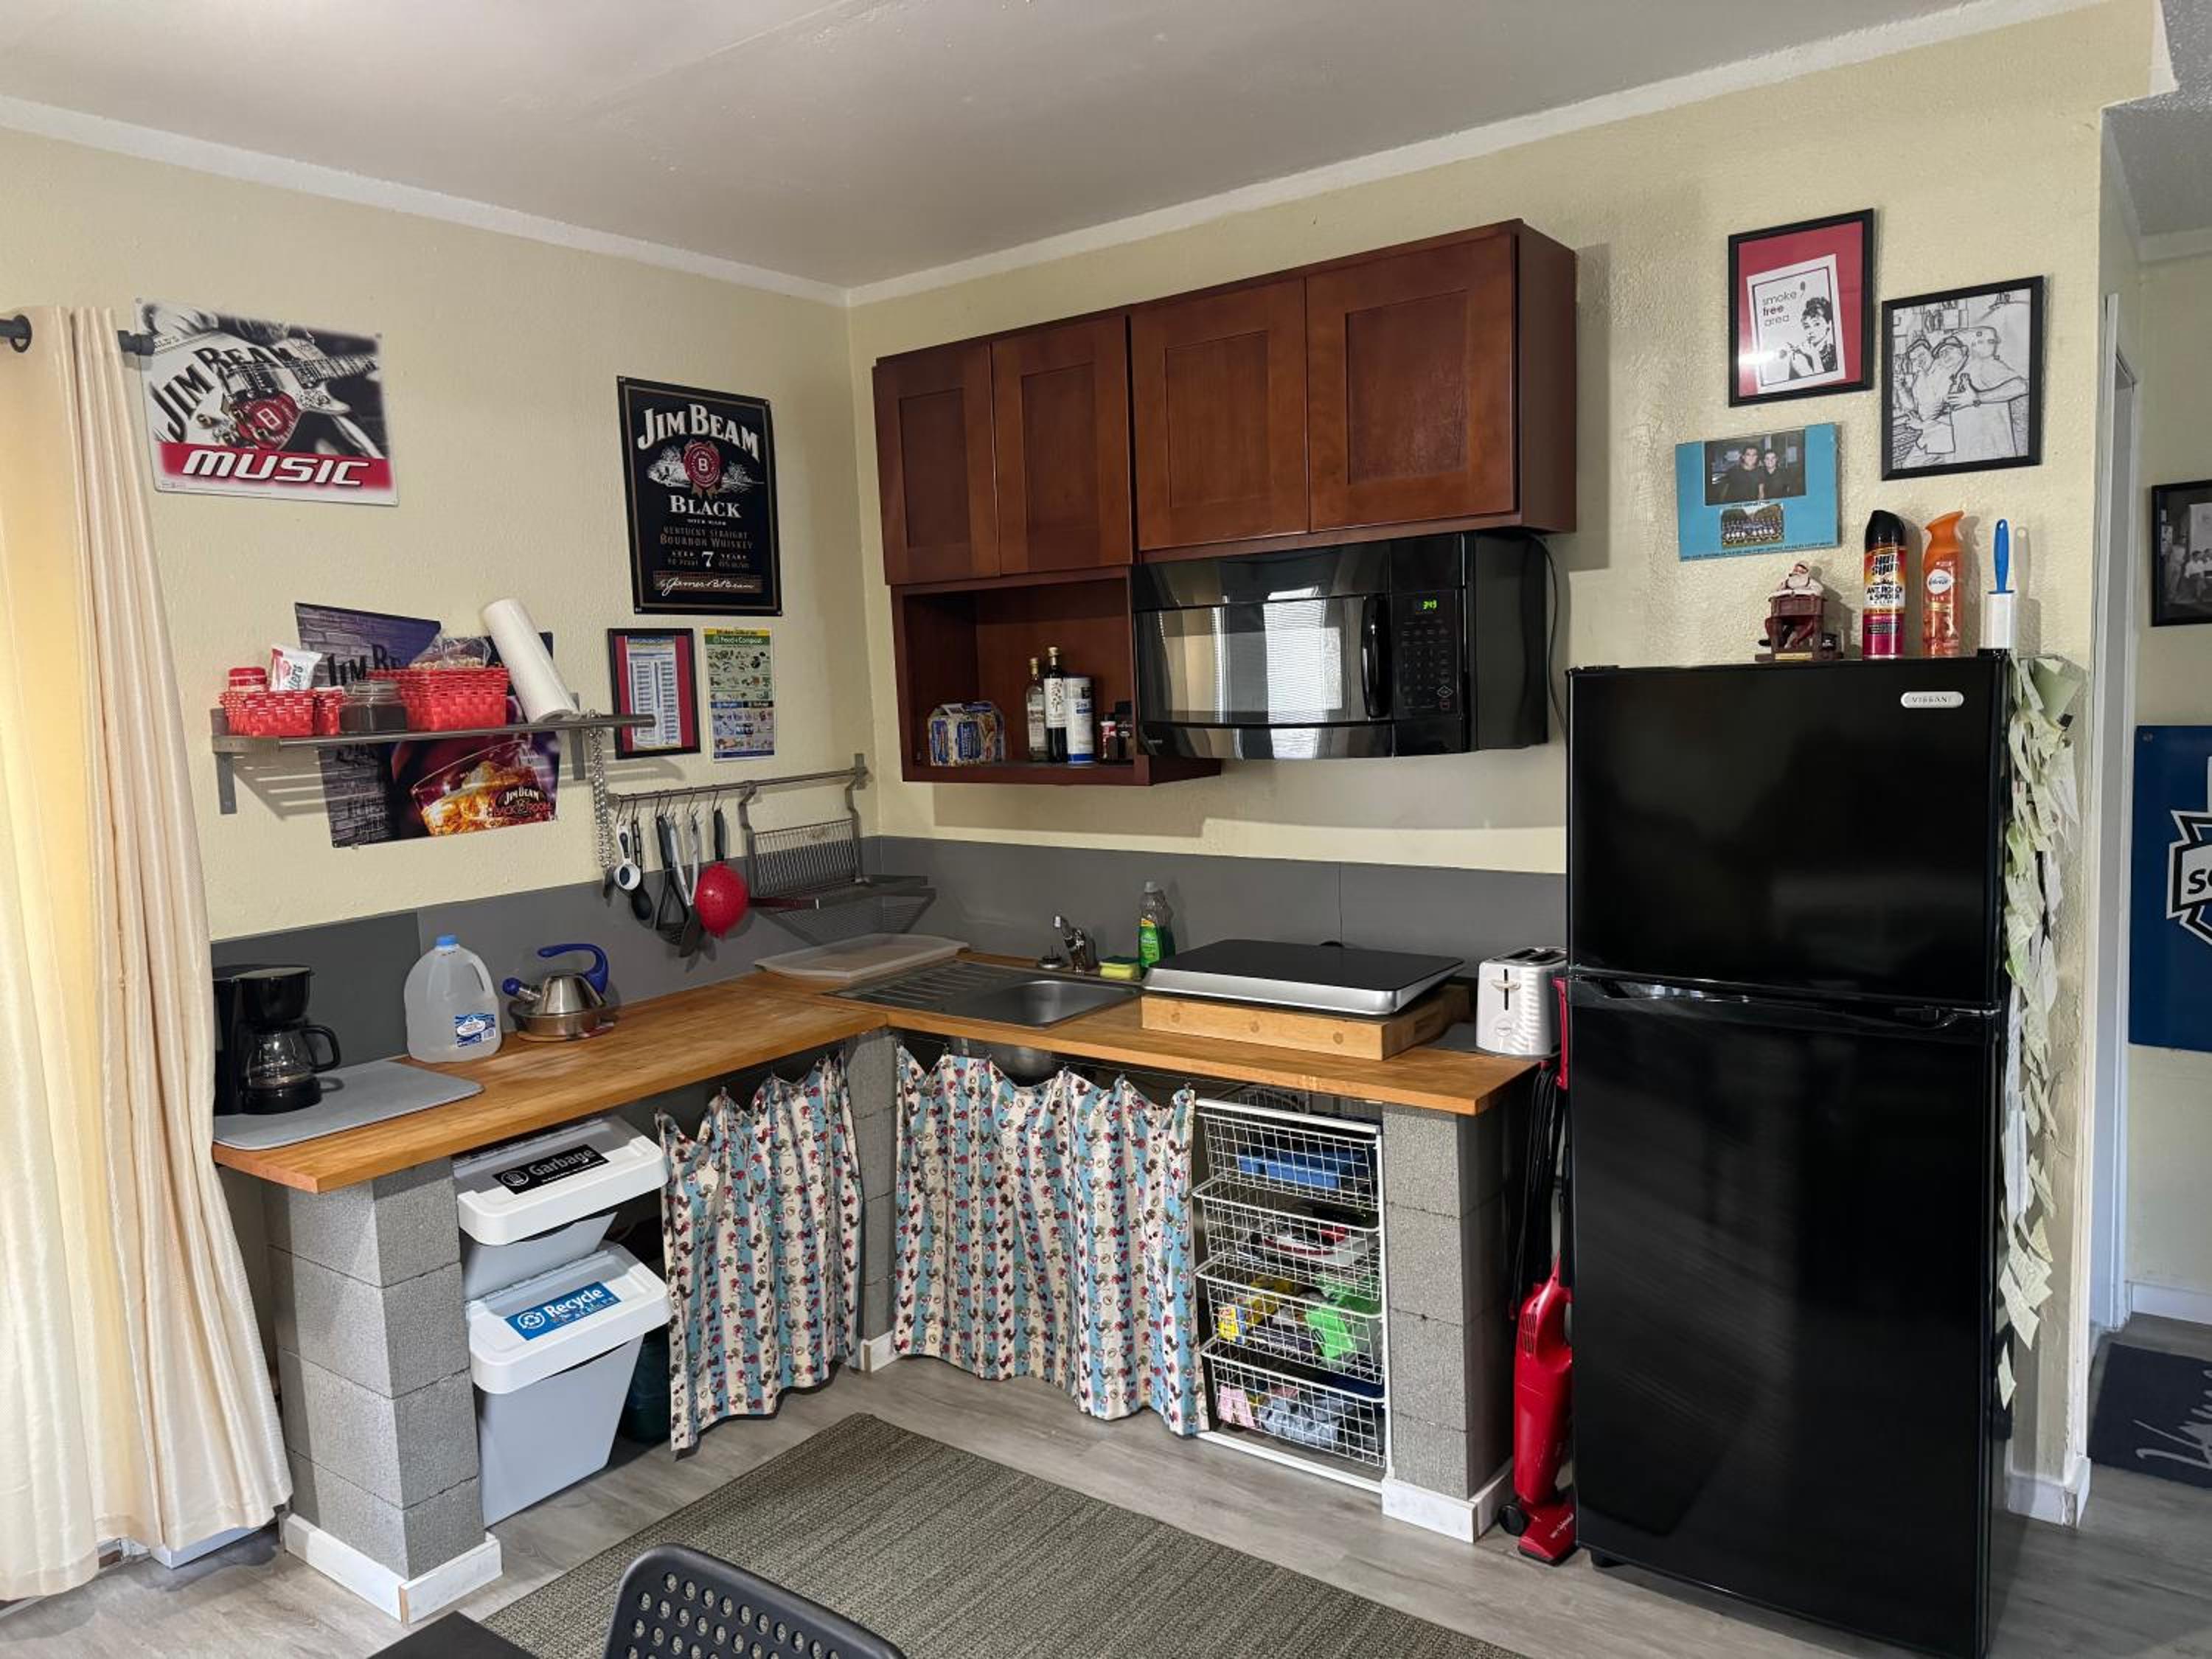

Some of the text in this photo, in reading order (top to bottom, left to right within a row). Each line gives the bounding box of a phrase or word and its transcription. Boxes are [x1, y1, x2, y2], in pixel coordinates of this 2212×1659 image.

[1762, 291, 1797, 305] smoke
[1763, 305, 1784, 316] free
[1764, 315, 1790, 327] area
[150, 347, 301, 442] JIM BEAM
[638, 403, 760, 461] JIM BEAM
[183, 448, 370, 486] MUSIC
[698, 458, 709, 471] B
[669, 495, 742, 518] BLACK
[660, 533, 754, 550] BOURBON WHISKEY
[663, 526, 748, 540] KENTUCKY STRAIGHT
[701, 551, 714, 567] 7
[529, 1148, 596, 1176] Garbage
[543, 1288, 604, 1318] Recycle
